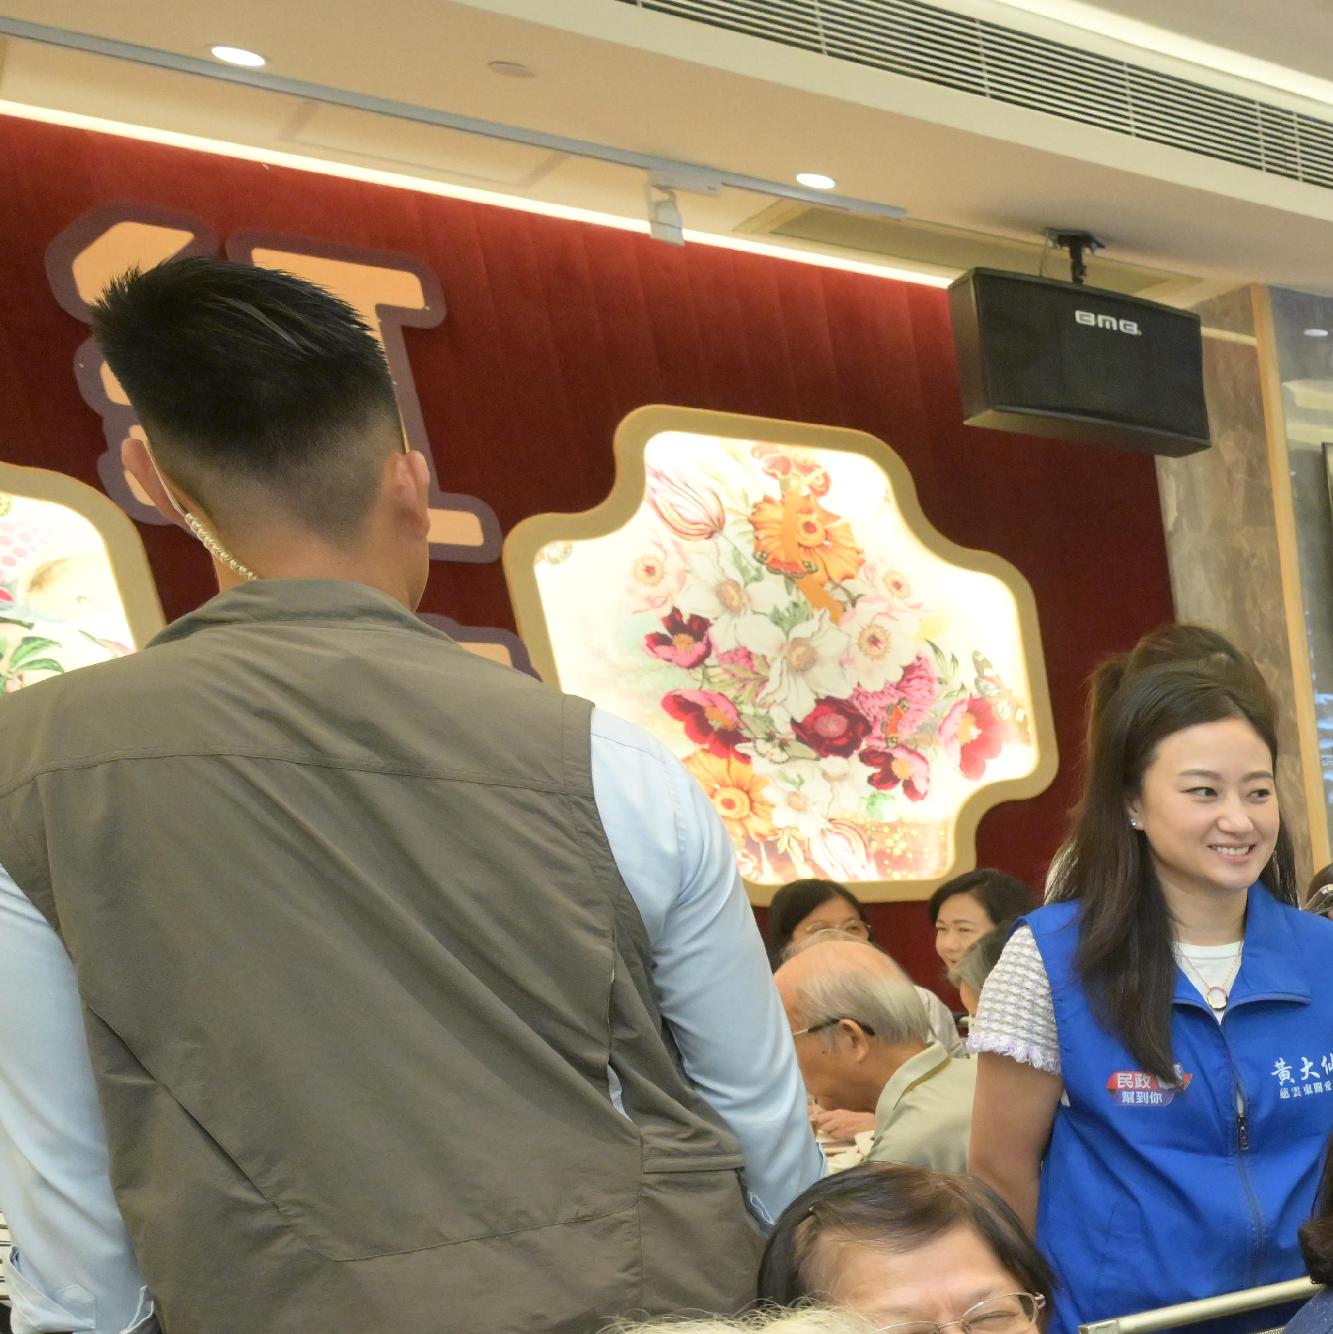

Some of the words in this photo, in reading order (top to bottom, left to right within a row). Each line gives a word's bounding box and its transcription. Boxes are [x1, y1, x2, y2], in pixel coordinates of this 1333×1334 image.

[1116, 1072, 1151, 1089] 民政
[1121, 1091, 1162, 1104] 幫到你
